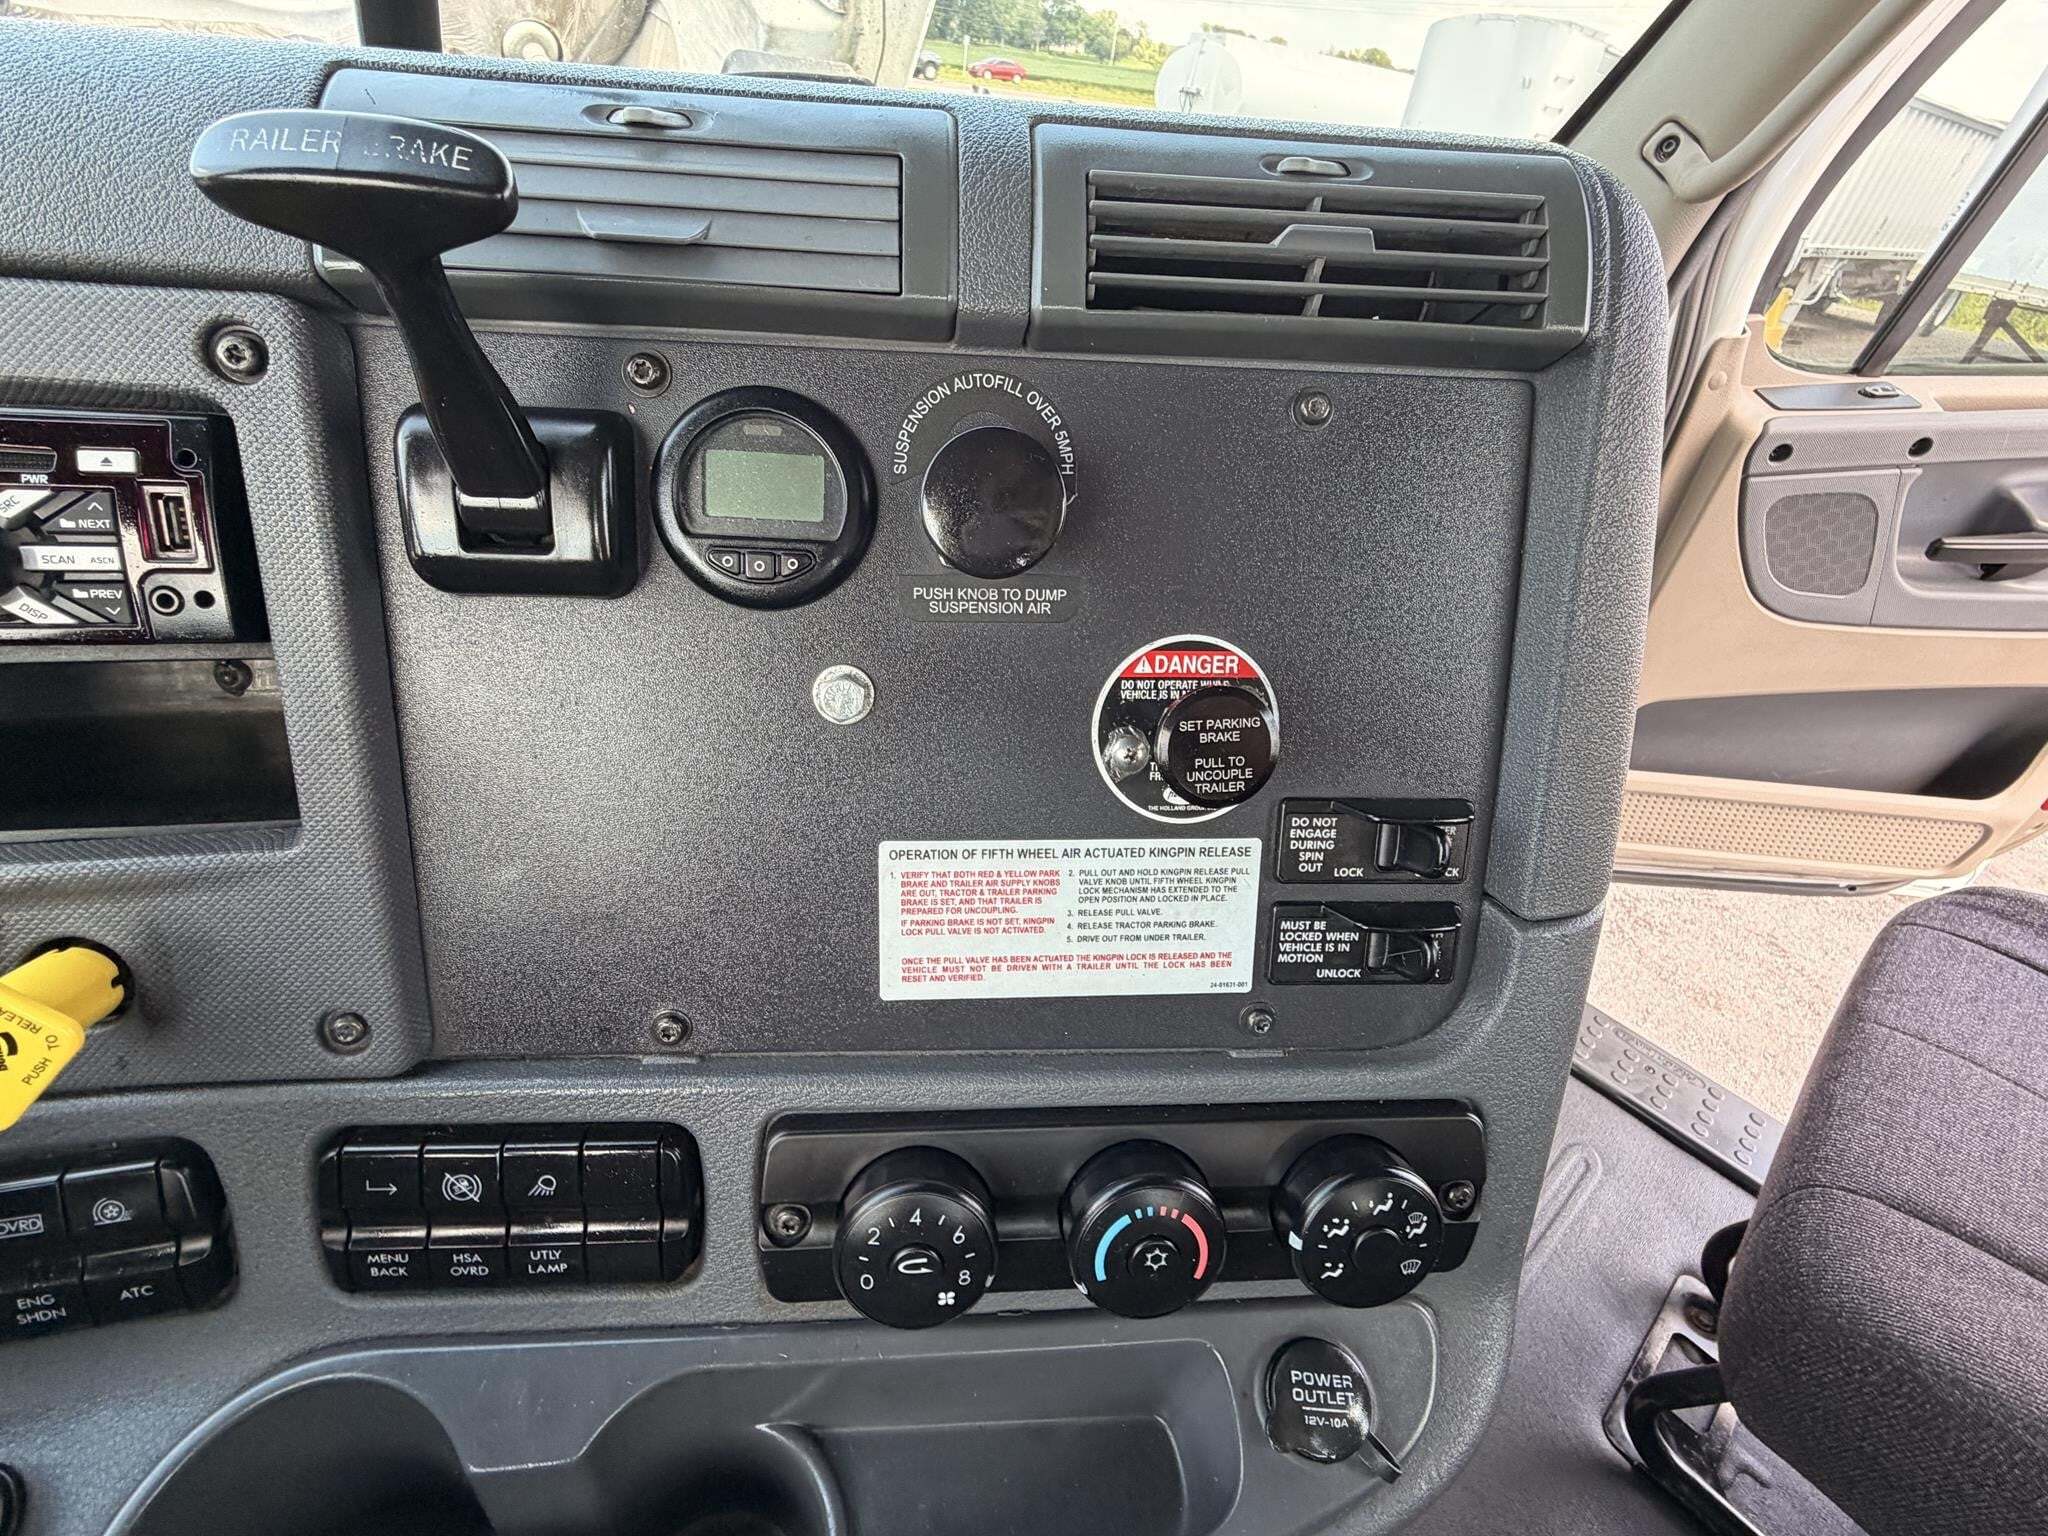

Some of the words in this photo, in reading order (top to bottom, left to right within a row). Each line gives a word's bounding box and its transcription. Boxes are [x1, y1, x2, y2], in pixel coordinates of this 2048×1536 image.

[893, 382, 951, 475] SUSPENSION
[954, 373, 1023, 398] AUTOFILL
[1027, 391, 1062, 431] OVER
[1054, 430, 1075, 475] 5MPH
[20, 473, 49, 485] PWR
[78, 518, 111, 529] NEXT
[41, 555, 75, 565] SCAN
[90, 589, 122, 600] PREV
[914, 588, 953, 600] PUSH
[958, 588, 998, 600] KNOB
[1002, 588, 1021, 601] TO
[1025, 589, 1067, 601] DUMP
[18, 602, 49, 620] DISP
[929, 601, 1024, 614] SUSPENSION
[1027, 602, 1051, 615] AIR
[1155, 655, 1239, 674] DANGER
[1121, 680, 1134, 690] DO
[1137, 680, 1156, 690] NOT
[1158, 680, 1198, 689] OPERATE
[1121, 690, 1156, 700] VEHICLE
[1159, 690, 1168, 700] IS
[1170, 690, 1180, 700] IN
[1179, 721, 1201, 731] SET
[1206, 717, 1261, 730] PARKING
[1200, 731, 1241, 743] BRAKE
[1195, 758, 1223, 769] PULL
[1228, 756, 1245, 767] TO
[1187, 768, 1253, 782] UNCOUPLE
[1195, 781, 1246, 794] TRAILER
[1292, 817, 1310, 827] DO
[1312, 817, 1338, 827] NOT
[1290, 829, 1337, 838] ENGAGE
[1290, 840, 1335, 850] DURING
[889, 849, 957, 860] OPERATION
[962, 849, 977, 859] OF
[981, 848, 1013, 859] FIFTH
[1017, 848, 1057, 858] WHEEL
[1061, 848, 1080, 858] AIR
[1084, 847, 1145, 858] ACTUATED
[1149, 846, 1195, 857] KINGPIN
[1199, 846, 1251, 856] RELEASE
[1299, 851, 1324, 861] SPIN
[1299, 863, 1323, 872] OUT
[1334, 867, 1364, 877] LOCK
[1281, 921, 1311, 930] MUST
[1314, 921, 1327, 930] BE
[1280, 932, 1322, 941] LOCKED
[1326, 932, 1359, 941] WHEN
[1279, 943, 1322, 952] VEHICLE
[1325, 943, 1334, 952] IS
[1338, 943, 1350, 952] IN
[1277, 954, 1324, 963] MOTION
[1316, 968, 1361, 978] UNLOCK
[21, 1057, 53, 1086] PUSH
[45, 1034, 60, 1051] TO
[868, 1227, 880, 1245] 2
[910, 1208, 921, 1226] 4
[953, 1226, 965, 1244] 6
[367, 1253, 409, 1264] MENU
[453, 1253, 483, 1264] HSA
[530, 1250, 561, 1261] UTLY
[370, 1266, 409, 1277] BACK
[450, 1266, 489, 1277] OVRD
[528, 1263, 568, 1274] LAMP
[860, 1275, 874, 1290] 0
[959, 1270, 971, 1285] 8
[119, 1285, 155, 1300] ATC
[17, 1294, 56, 1310] ENG
[16, 1308, 67, 1326] SHDN
[1290, 1370, 1353, 1388] POWER
[1292, 1387, 1355, 1404] OUTLET
[1304, 1414, 1349, 1428] 12V-10A
